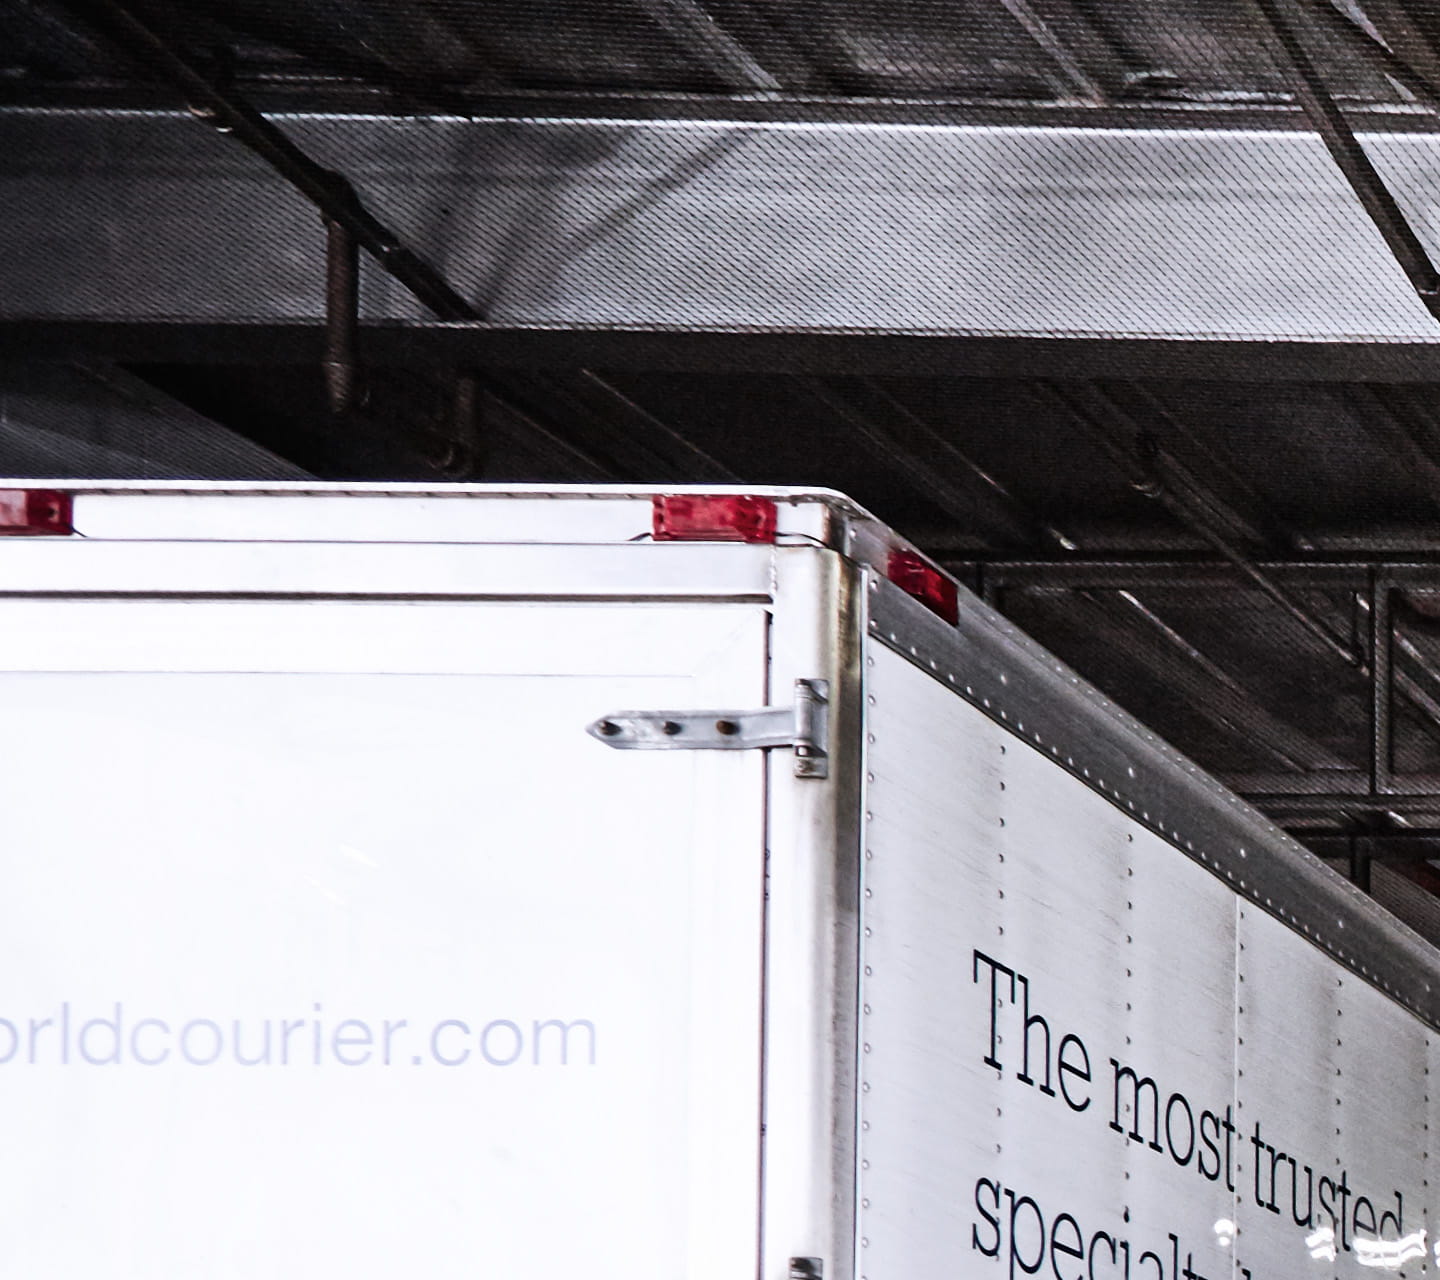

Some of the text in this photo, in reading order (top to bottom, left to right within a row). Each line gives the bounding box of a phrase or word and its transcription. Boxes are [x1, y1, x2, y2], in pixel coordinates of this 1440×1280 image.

[973, 950, 1403, 1253] The most trusted
